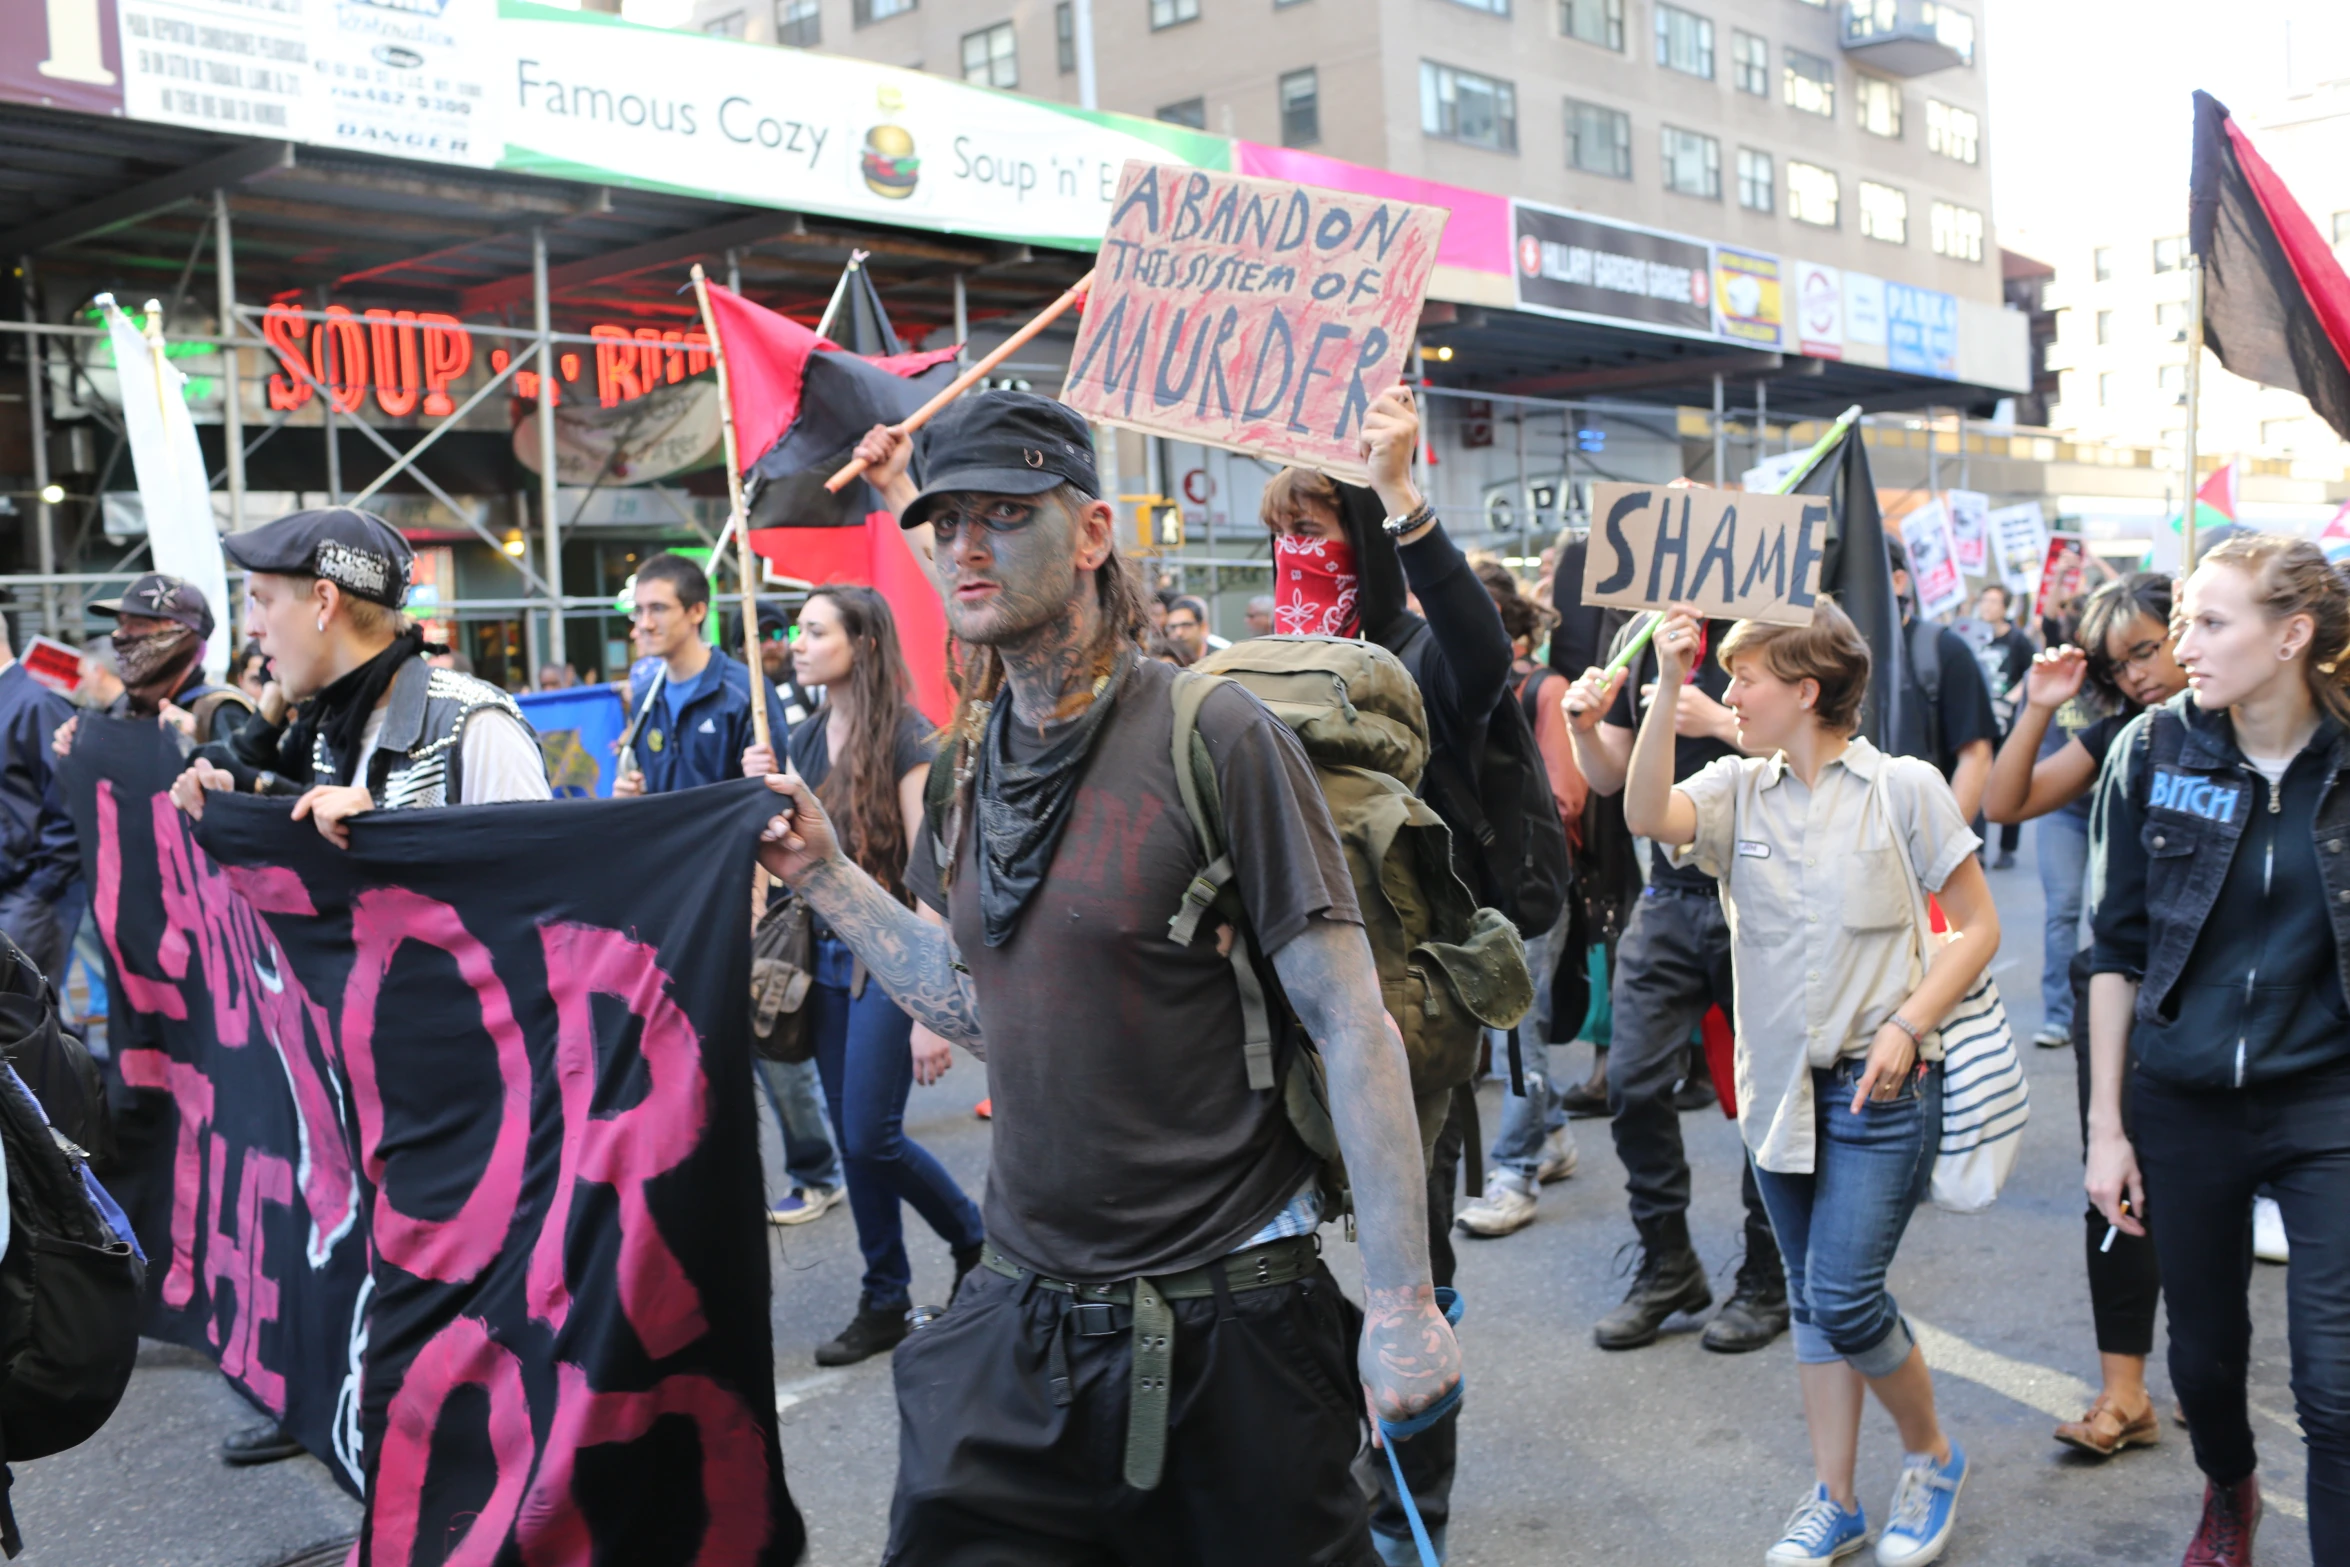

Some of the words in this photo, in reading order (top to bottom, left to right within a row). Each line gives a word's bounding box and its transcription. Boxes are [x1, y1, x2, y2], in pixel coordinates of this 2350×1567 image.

[336, 122, 469, 153] DANGER
[517, 57, 697, 136] Famous
[718, 95, 829, 169] Cozy
[953, 134, 1037, 203] Soup
[1110, 166, 1411, 262] ABANDON
[1311, 268, 1381, 304] OF
[263, 302, 473, 416] SOUP
[1066, 292, 1389, 440] MURDER
[1595, 491, 1828, 608] SHAME
[2147, 771, 2240, 823] BITCH
